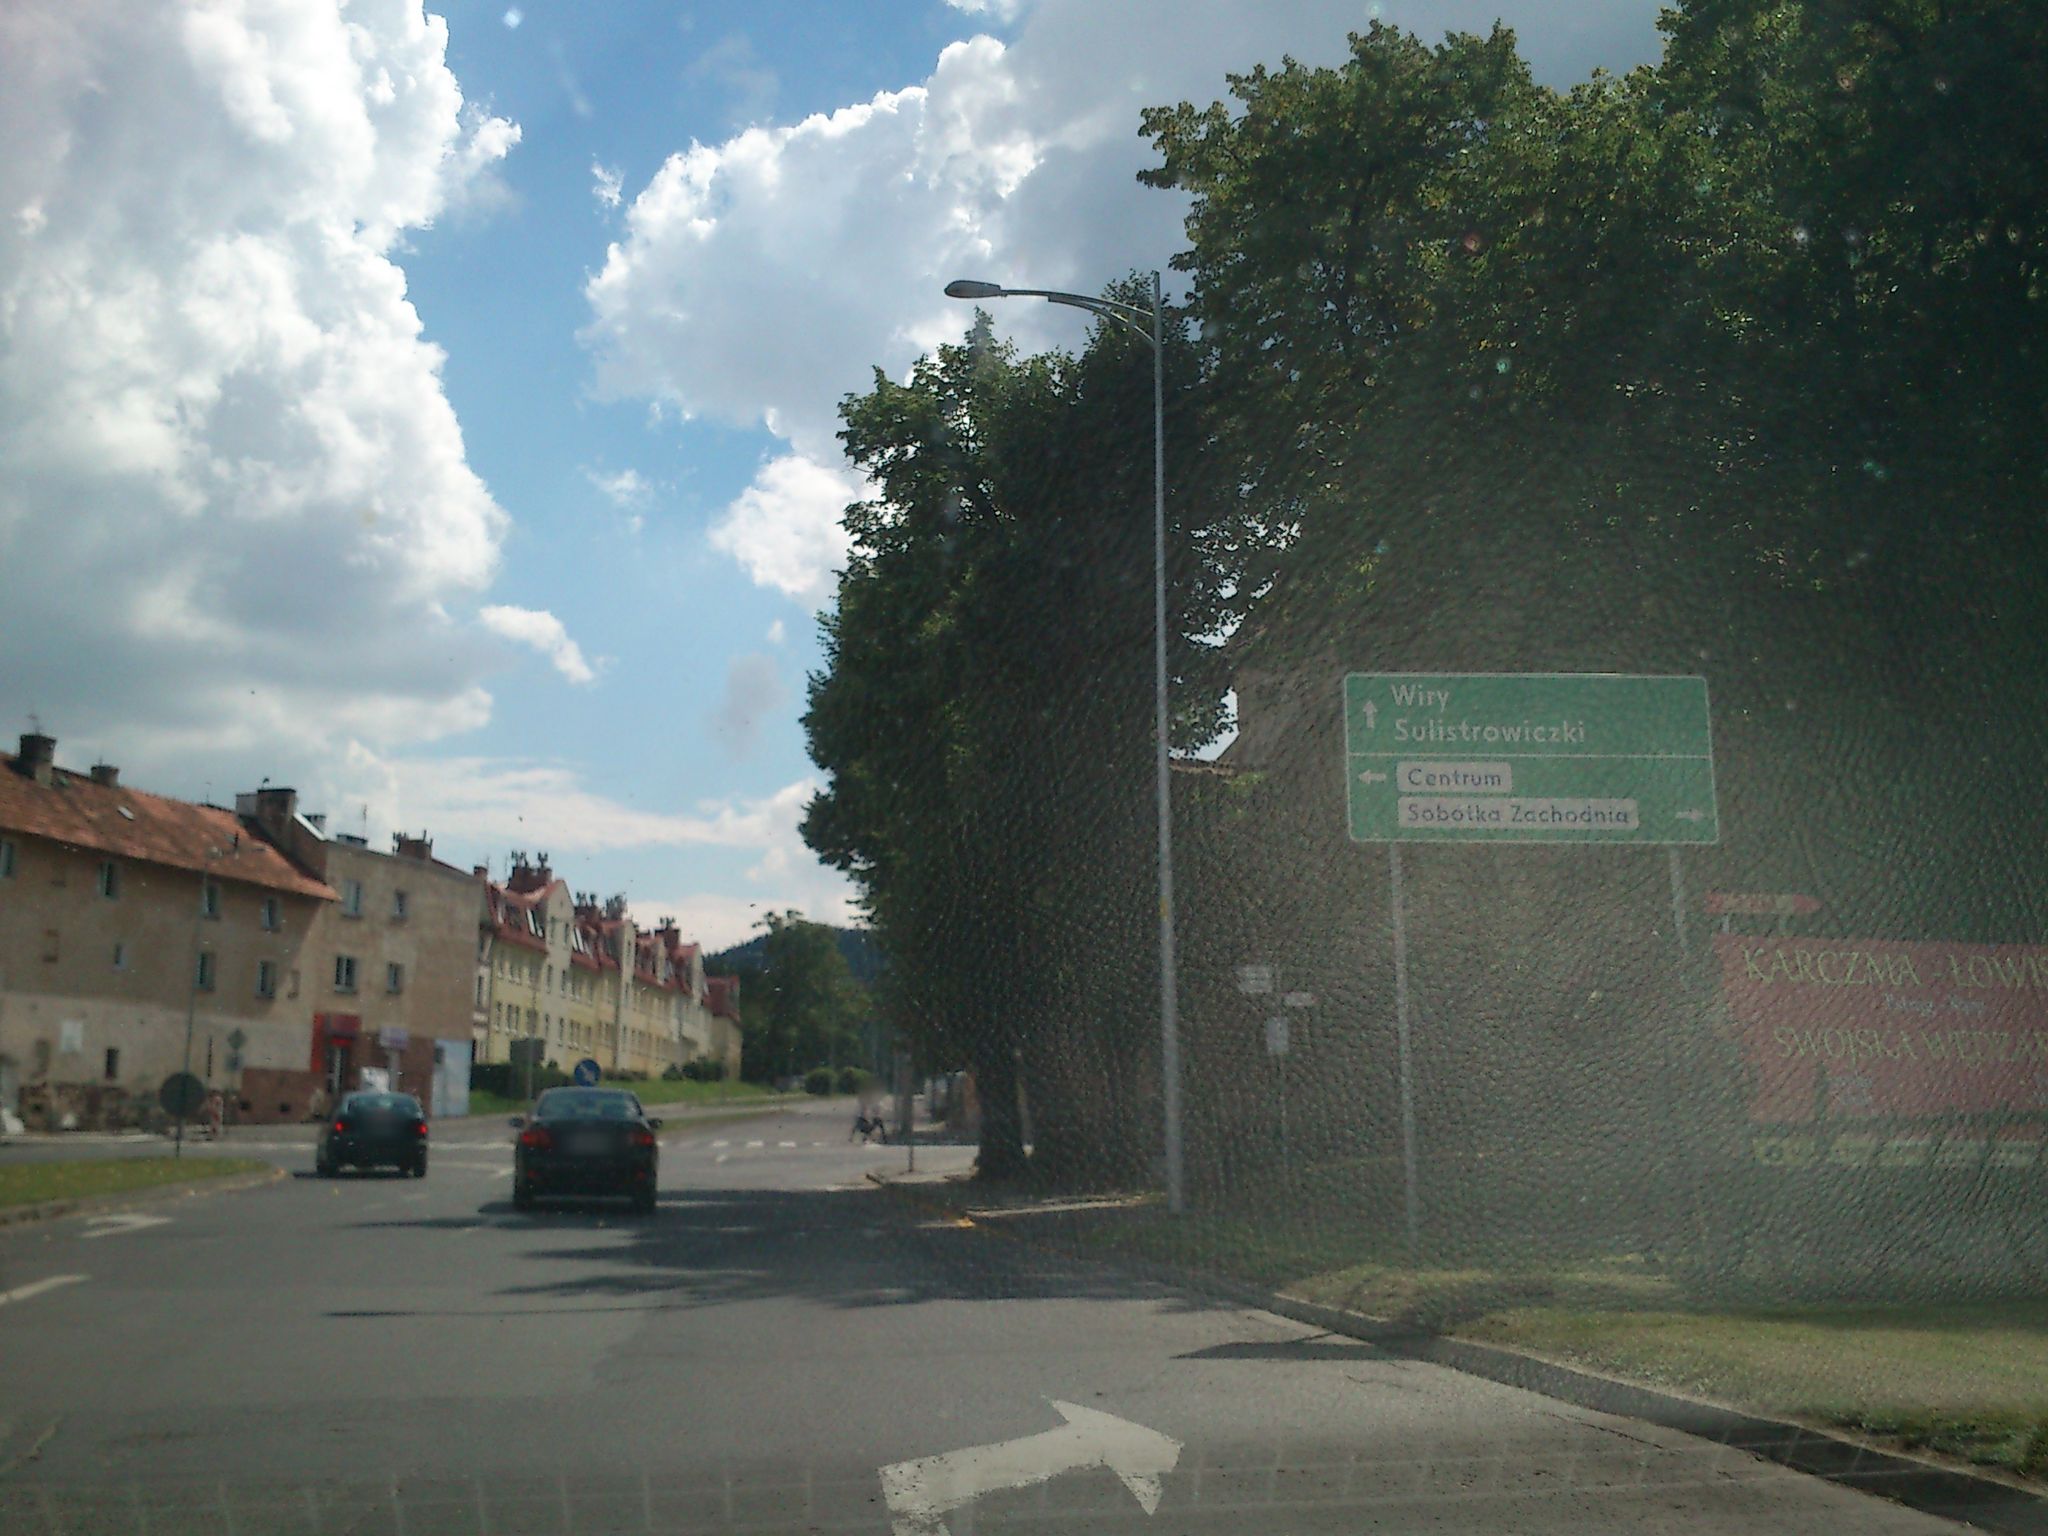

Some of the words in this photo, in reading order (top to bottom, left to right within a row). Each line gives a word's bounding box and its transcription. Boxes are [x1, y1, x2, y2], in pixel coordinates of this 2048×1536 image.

[1391, 684, 1450, 712] Wiry
[1394, 719, 1585, 743] Sulistrowiczki
[1408, 768, 1502, 786] Centrum
[1510, 803, 1629, 824] Zachodnia
[1740, 944, 1922, 985] KARCZMA
